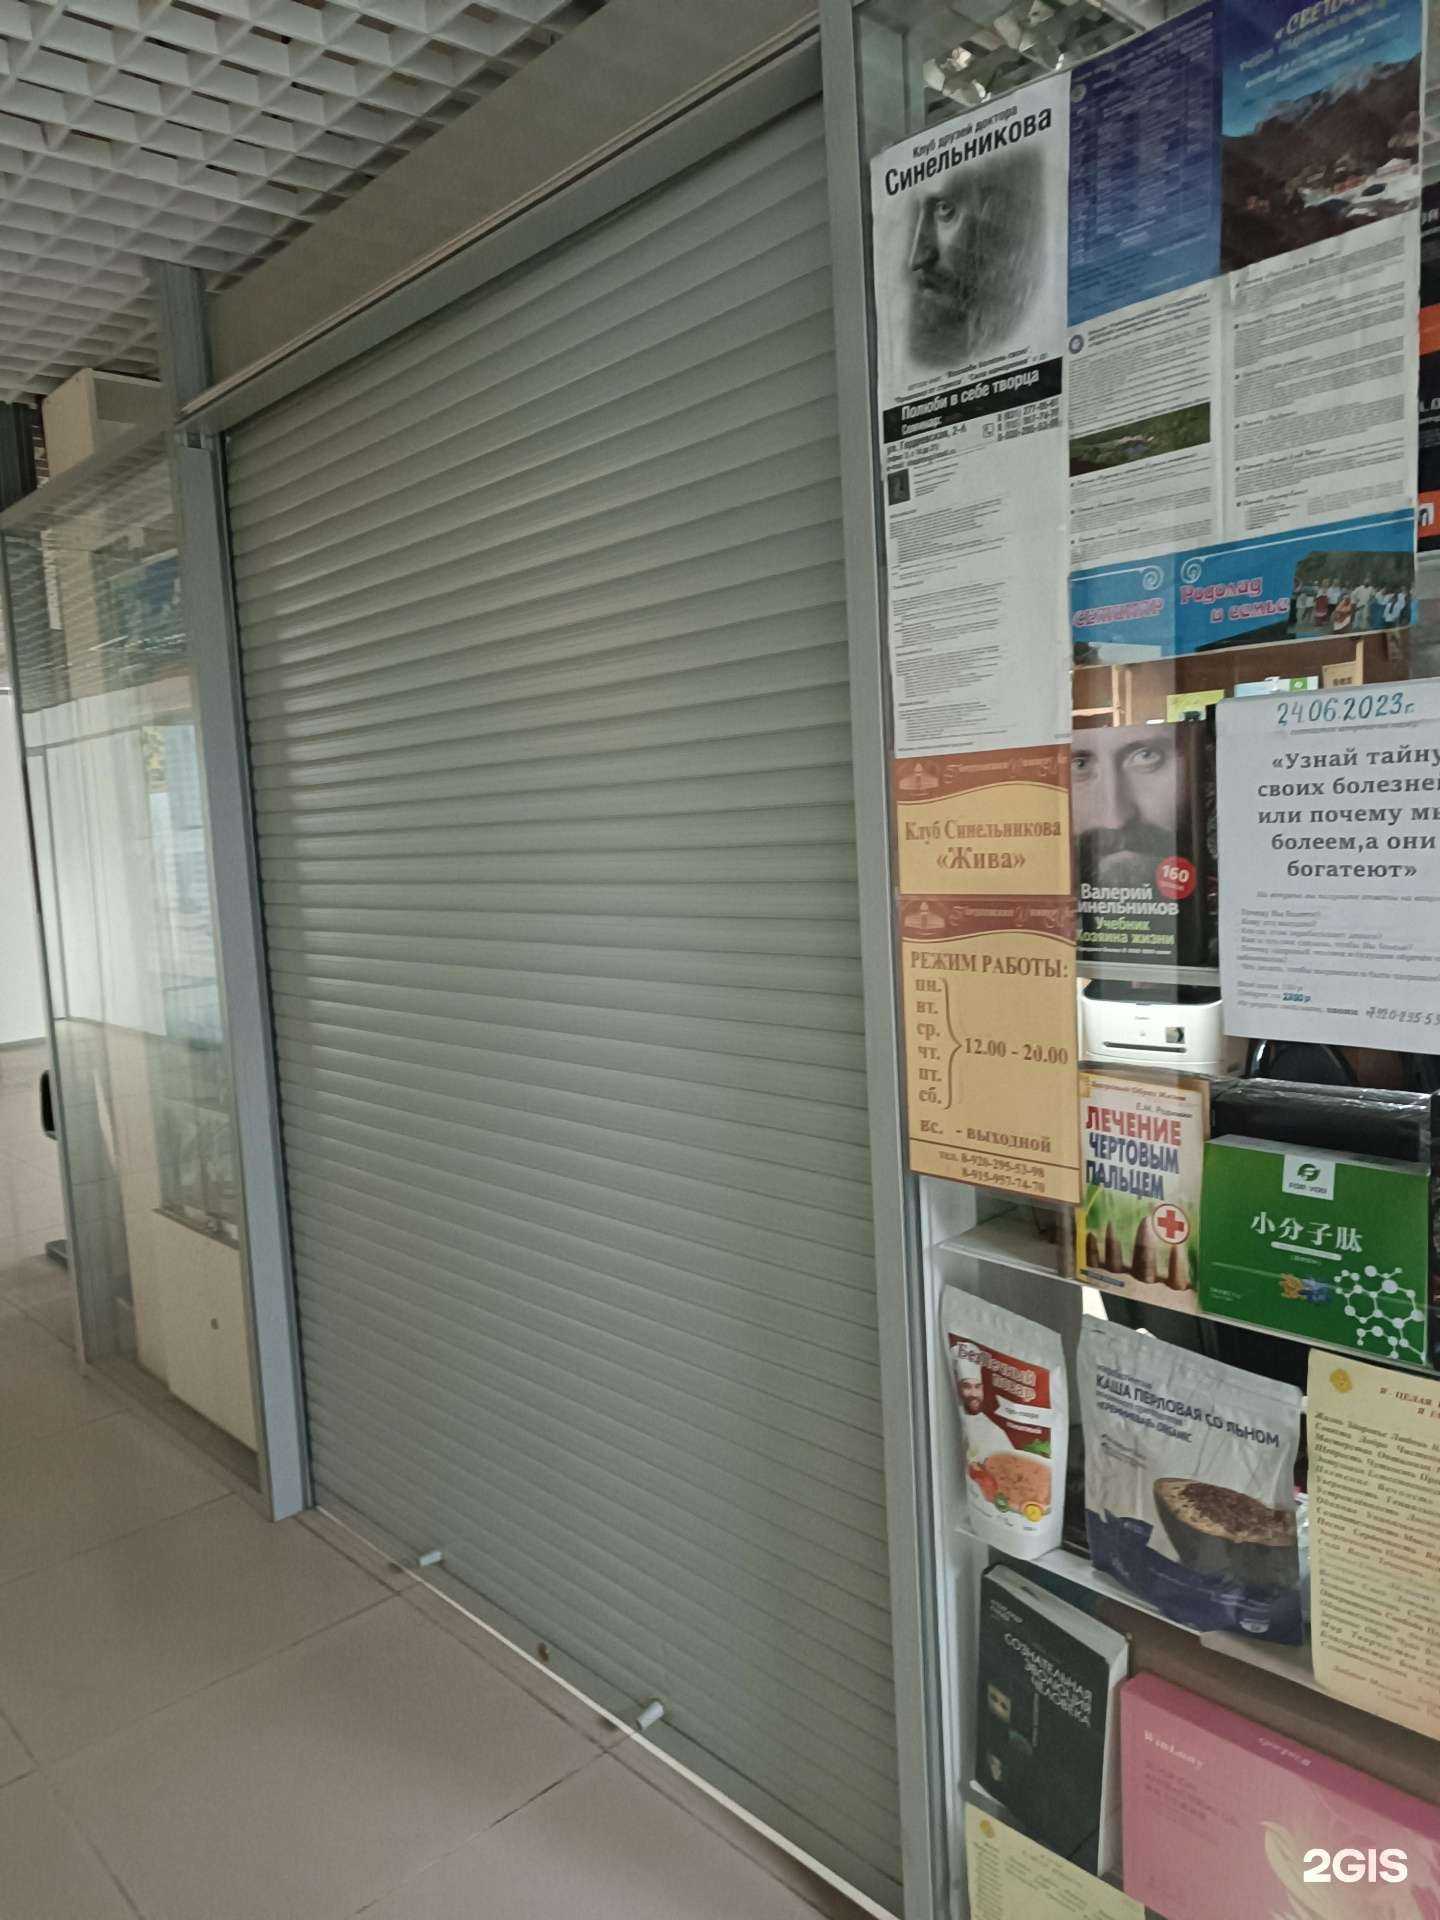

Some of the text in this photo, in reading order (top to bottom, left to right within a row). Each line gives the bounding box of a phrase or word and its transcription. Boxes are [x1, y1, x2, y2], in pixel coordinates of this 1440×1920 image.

[885, 107, 1052, 196] Синельникова
[960, 383, 990, 404] себе
[992, 368, 1040, 394] творца
[1272, 744, 1440, 769] «Узнай тайну
[1258, 777, 1440, 797] своих болезне
[1258, 809, 1302, 824] или
[1310, 807, 1402, 826] почему
[905, 819, 1061, 845] Клуб Синельникова
[1387, 835, 1436, 850] они
[936, 847, 1026, 870] «Жива»
[1287, 860, 1417, 878] богатеют»
[1161, 865, 1190, 884] 160
[1080, 883, 1153, 903] Валерий
[1078, 901, 1180, 916] инельников
[911, 951, 1069, 978] РЕЖИМ РАБОТЫ:
[915, 979, 942, 993] пн.
[916, 1001, 938, 1014] вт.
[916, 1024, 940, 1040] ср.
[918, 1046, 941, 1061] чт.
[965, 1037, 1006, 1058] 12.00
[1023, 1044, 1069, 1065] 20.00
[919, 1068, 942, 1082] пт.
[918, 1087, 942, 1105] сб.
[920, 1120, 943, 1135] вс.
[967, 1127, 1051, 1153] выходной
[1086, 1105, 1182, 1147] ЛЕЧЕНИЕ
[1088, 1131, 1180, 1175] ЧЕРТОВЫМ
[1086, 1159, 1164, 1201] ПАЛЬЦЕМ
[1250, 1211, 1363, 1253] 小分子肽
[1096, 1373, 1132, 1400] КАША
[1134, 1388, 1203, 1423] ПЕРЛОВАЯ
[1205, 1412, 1224, 1429] СО
[1226, 1421, 1281, 1448] ЛЬНОМ
